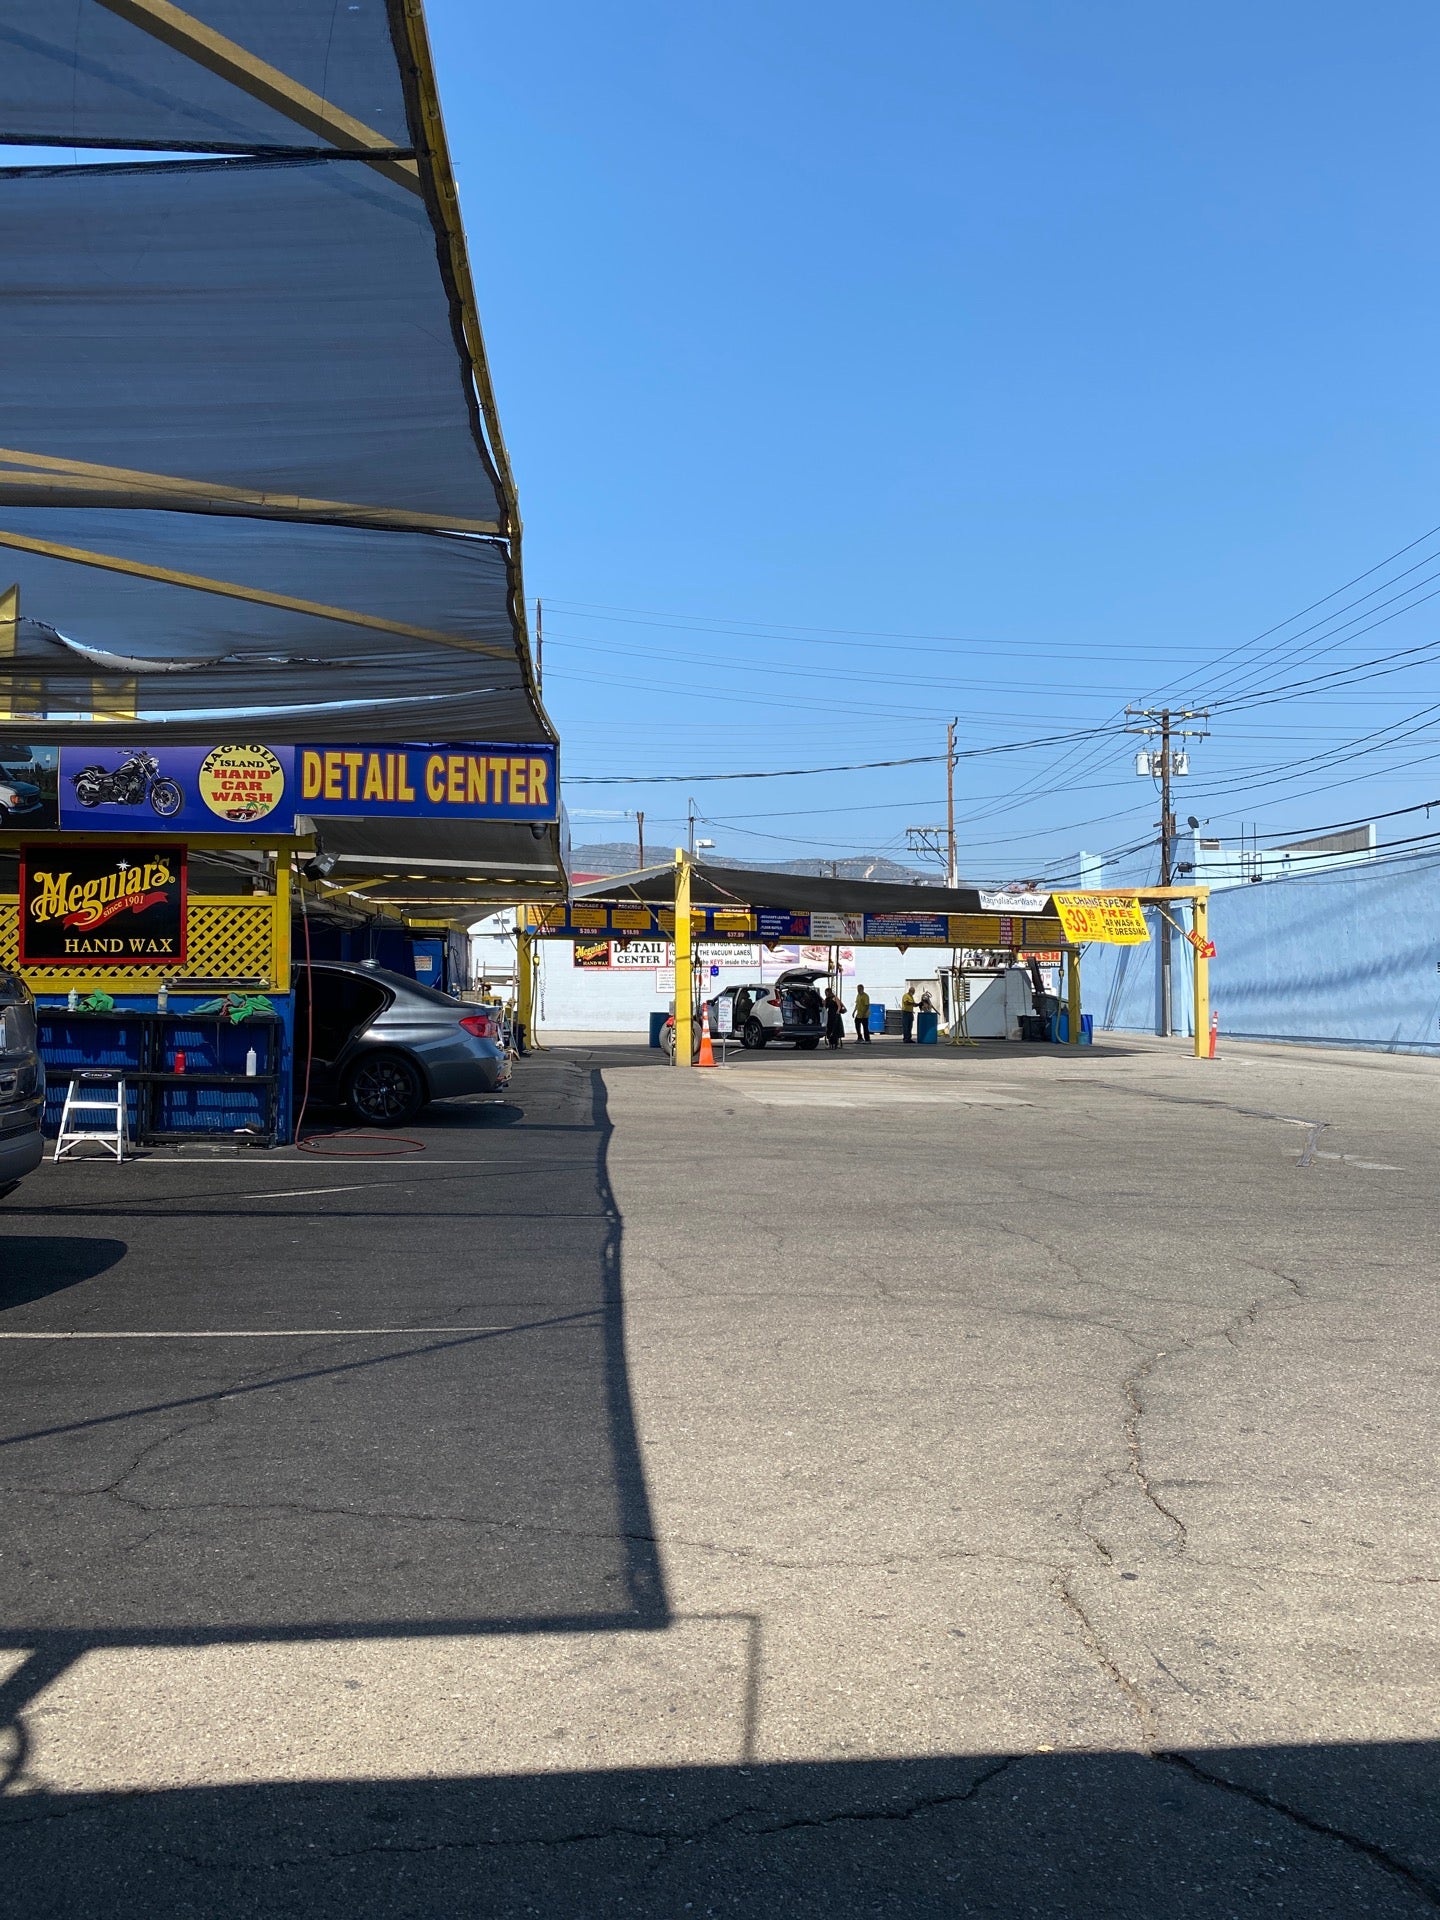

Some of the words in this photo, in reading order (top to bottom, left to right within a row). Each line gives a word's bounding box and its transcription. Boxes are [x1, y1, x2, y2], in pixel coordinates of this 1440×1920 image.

[203, 744, 280, 774] MAGNOLIA
[219, 759, 265, 768] ISLAND
[213, 769, 271, 780] HAND
[302, 751, 415, 801] DETAIL
[425, 755, 549, 804] CENTER
[221, 780, 263, 791] CAR
[211, 792, 273, 802] WASH
[1057, 896, 1073, 905] OIL
[103, 901, 123, 918] since
[124, 895, 144, 907] 1901
[1100, 909, 1134, 919] FREE
[1114, 919, 1134, 927] WASH
[1115, 926, 1147, 937] DRESSING
[64, 938, 124, 953] HAND
[128, 938, 173, 953] WAX
[614, 943, 664, 953] DETAIL
[1189, 930, 1208, 952] LINE
[1204, 947, 1214, 957] 4
[617, 955, 661, 964] CENTER
[1021, 951, 1060, 960] WASH
